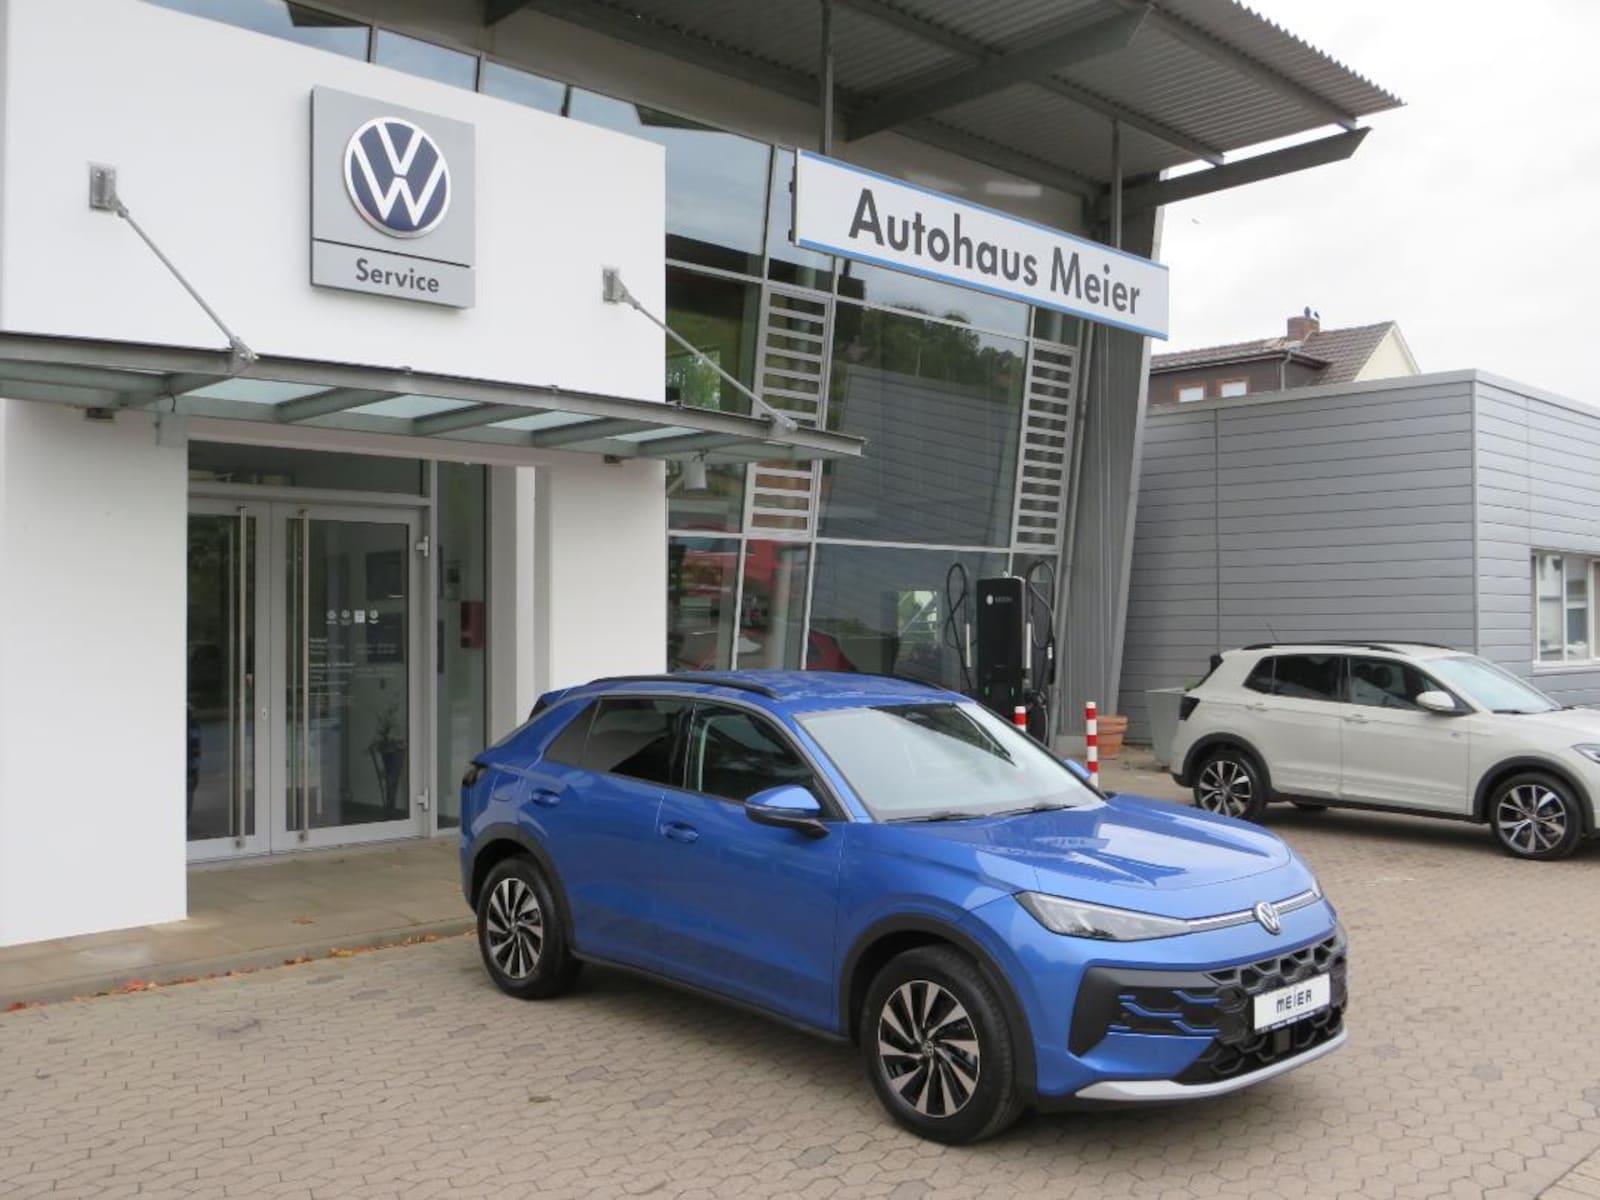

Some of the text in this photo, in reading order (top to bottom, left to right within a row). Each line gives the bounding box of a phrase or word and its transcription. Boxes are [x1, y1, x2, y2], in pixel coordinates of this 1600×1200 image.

[347, 118, 449, 235] VW
[356, 258, 439, 292] Service
[848, 188, 1140, 314] Autohaus Meier
